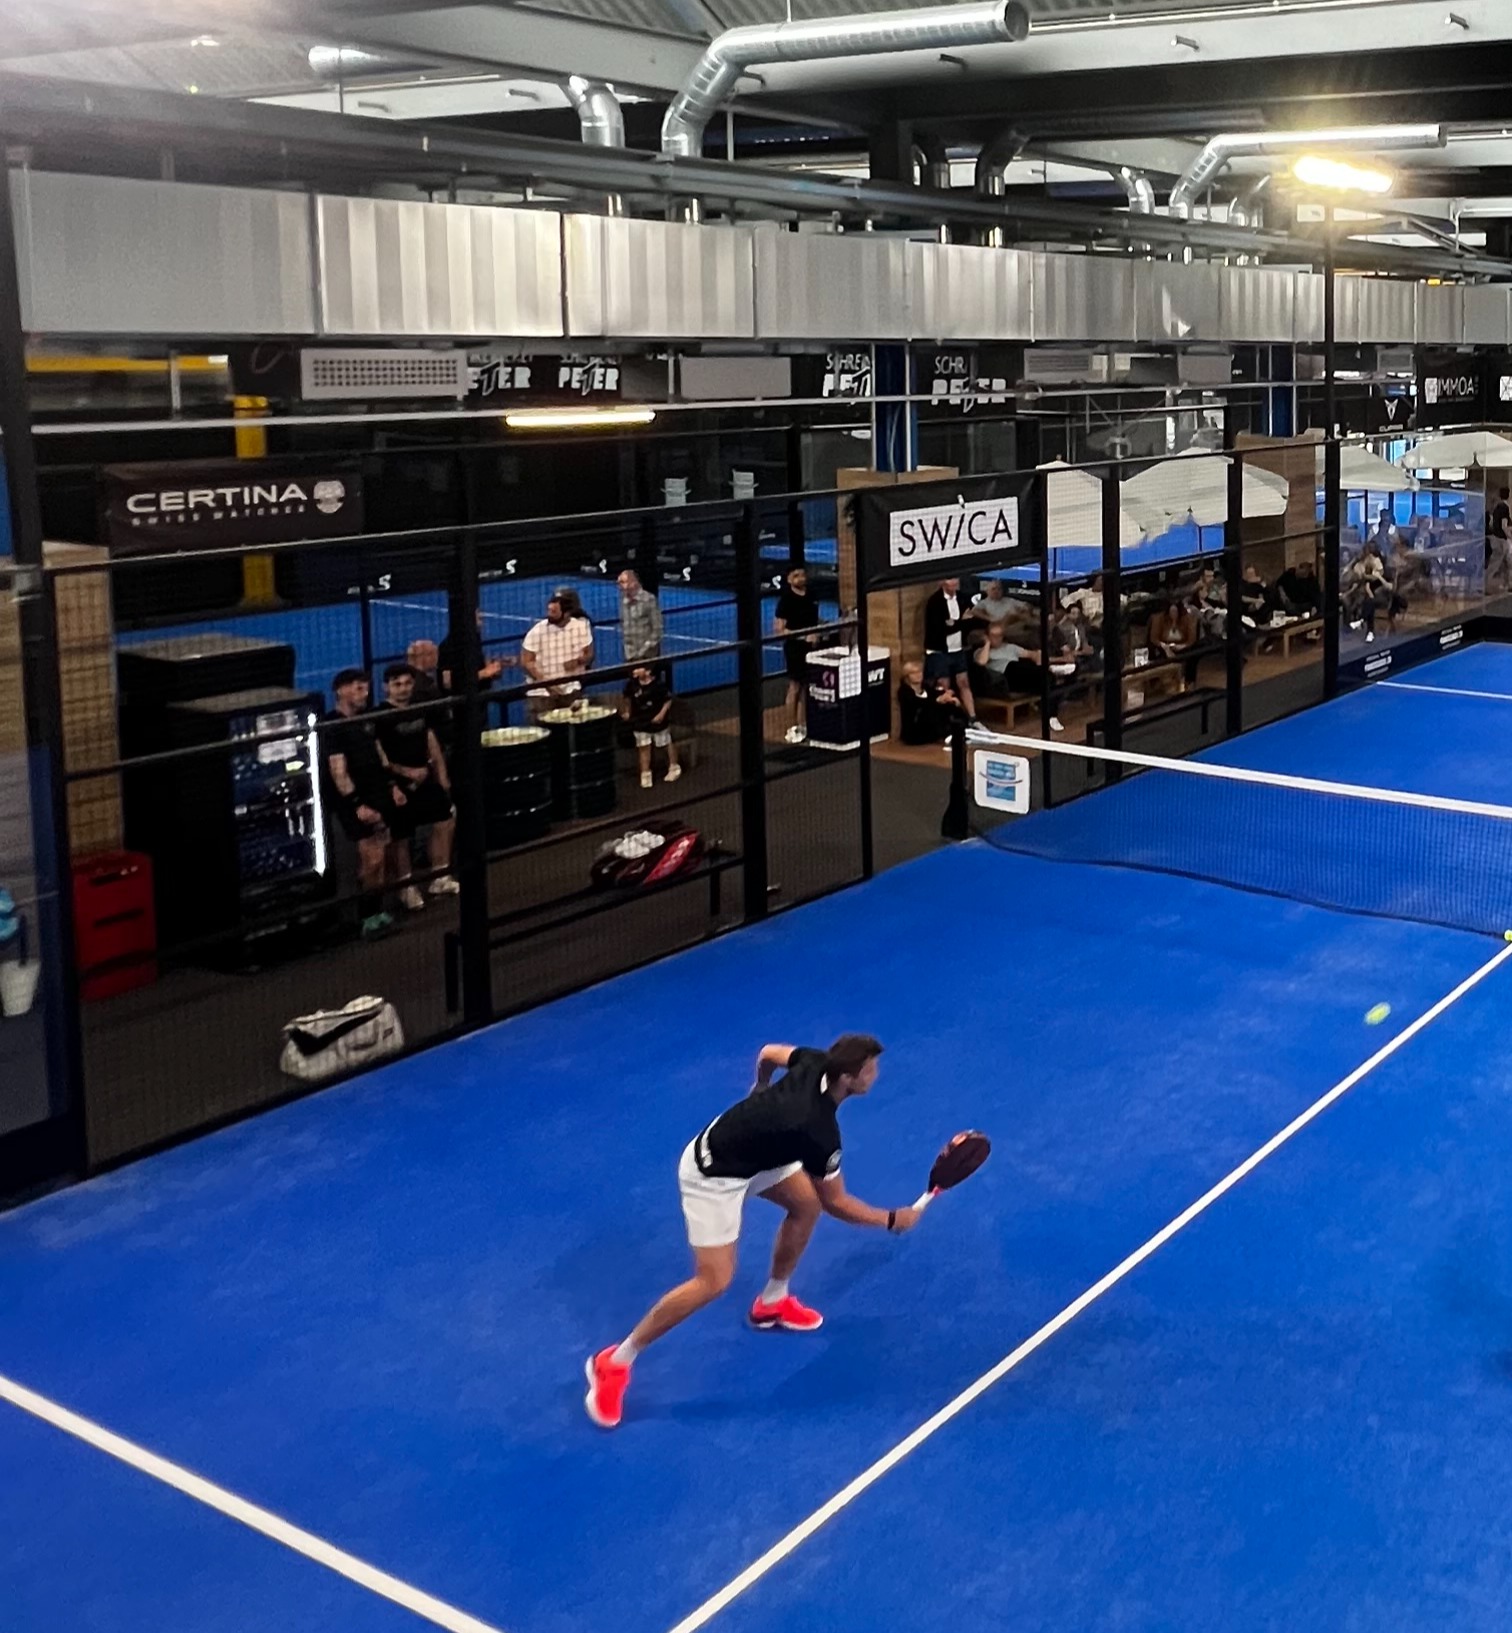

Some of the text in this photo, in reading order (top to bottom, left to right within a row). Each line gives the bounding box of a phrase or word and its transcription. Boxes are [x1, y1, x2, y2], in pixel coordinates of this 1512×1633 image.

[1438, 376, 1474, 396] IMMOA
[126, 483, 307, 513] CERTINA
[897, 494, 1012, 557] SWICA
